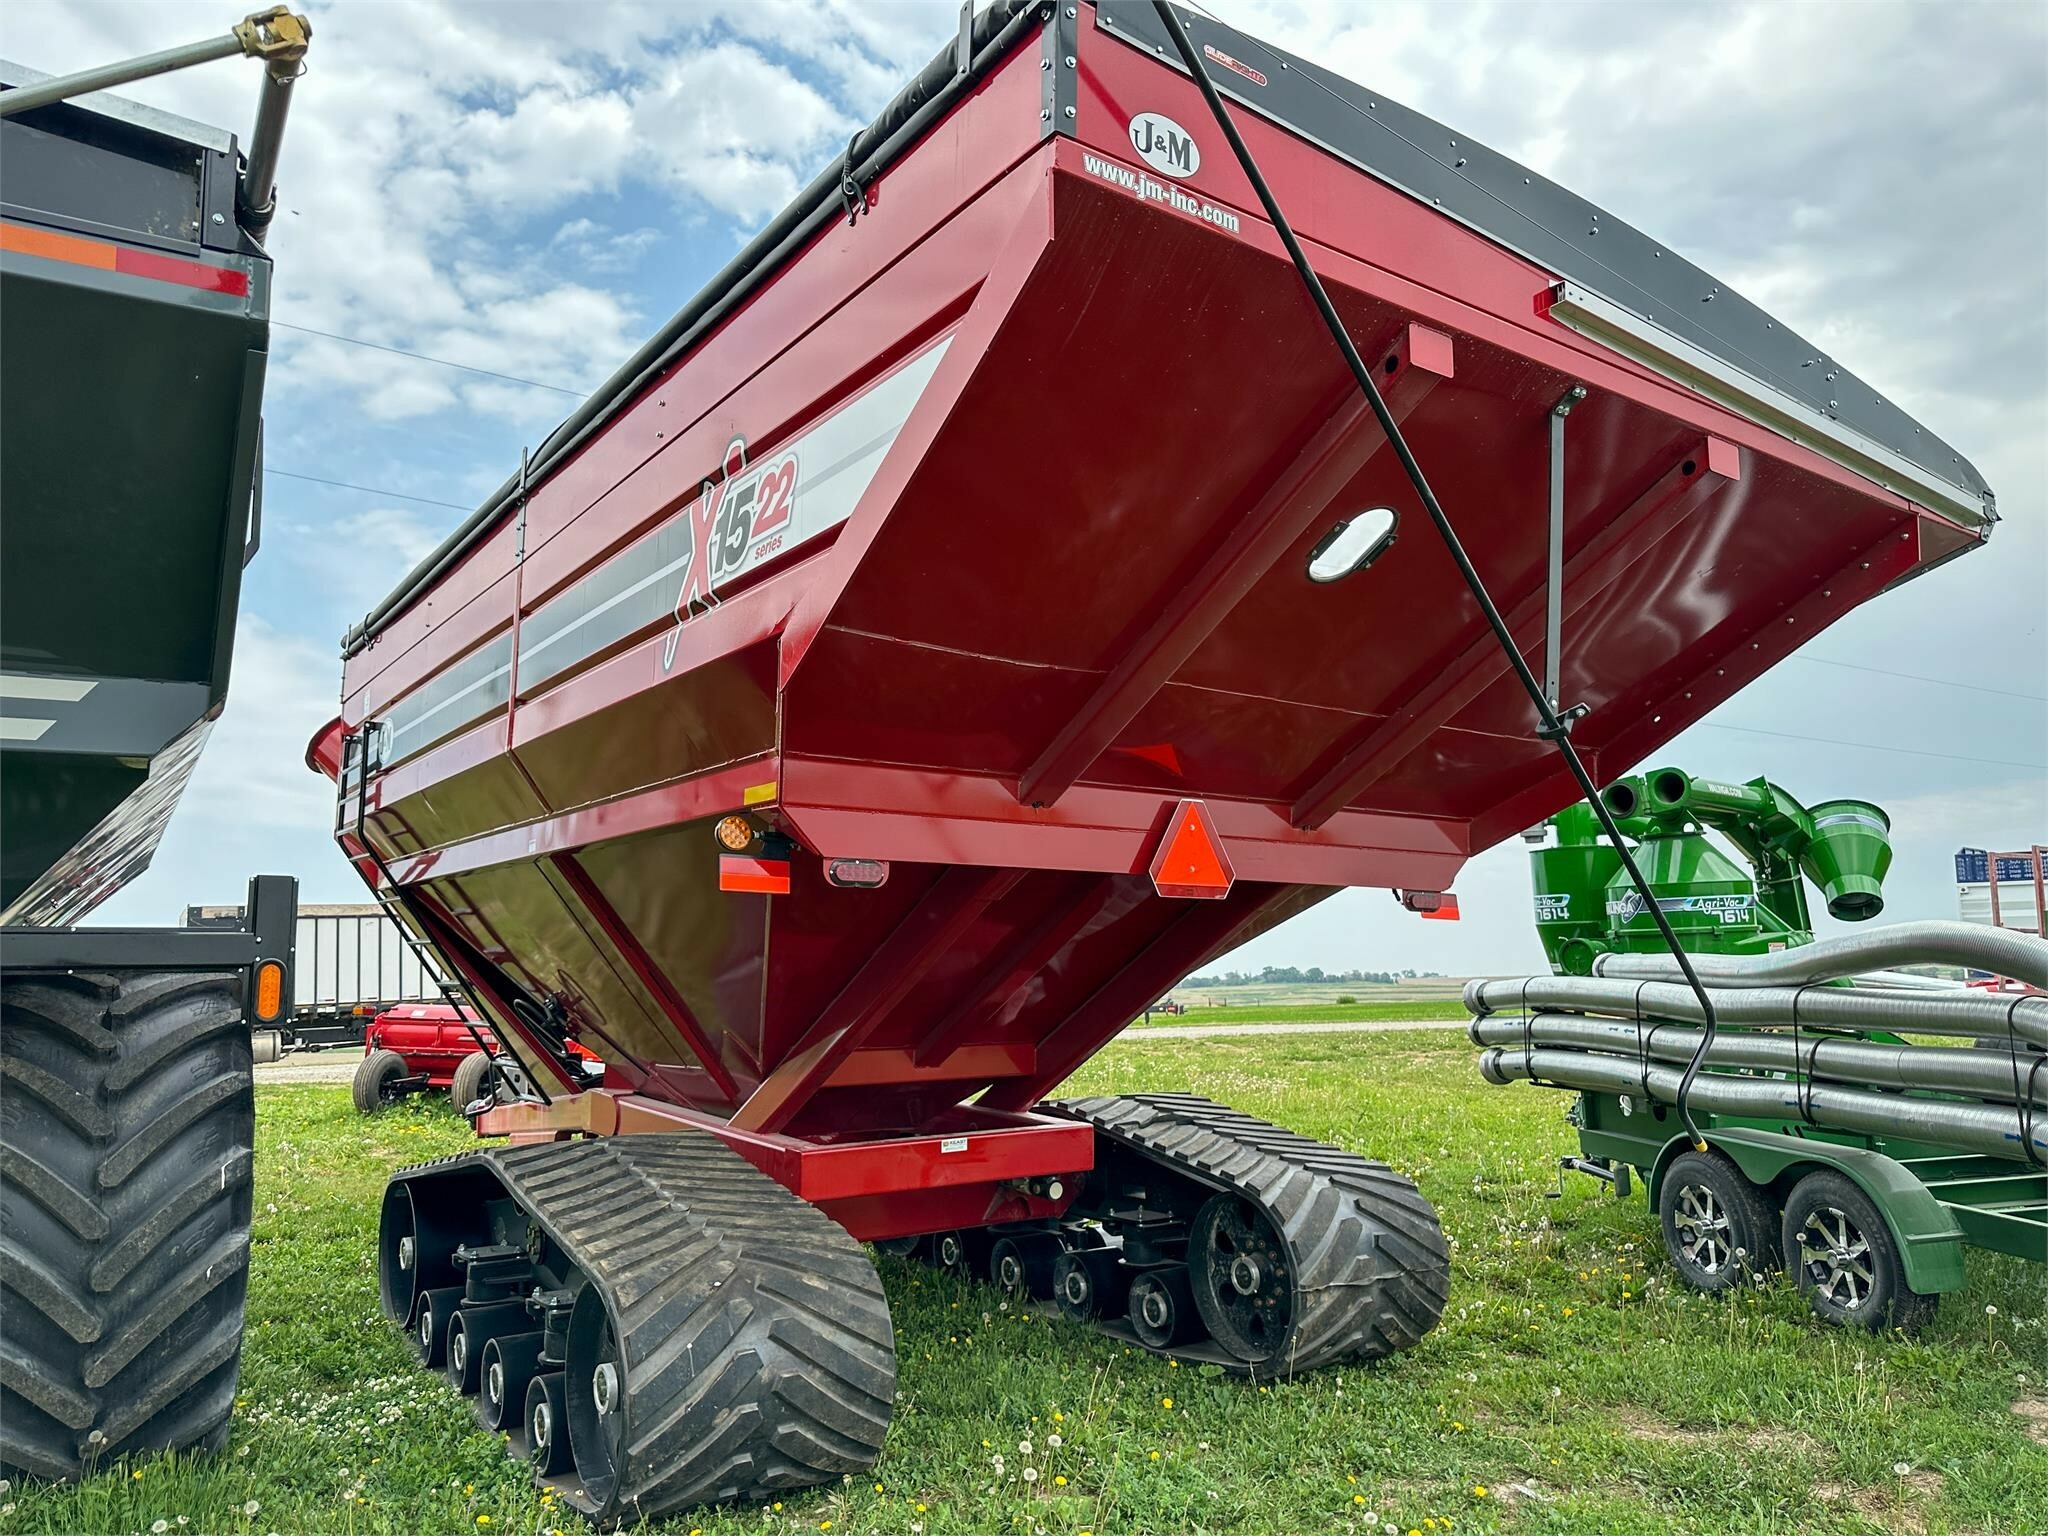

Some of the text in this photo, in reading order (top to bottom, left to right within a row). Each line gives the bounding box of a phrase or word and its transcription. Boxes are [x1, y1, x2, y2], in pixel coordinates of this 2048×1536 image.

[1133, 120, 1191, 172] J&M
[1084, 154, 1239, 232] www.jm-inc.com
[755, 534, 782, 560] series
[1695, 897, 1740, 914] Agri-Vac
[1711, 909, 1749, 923] 7614
